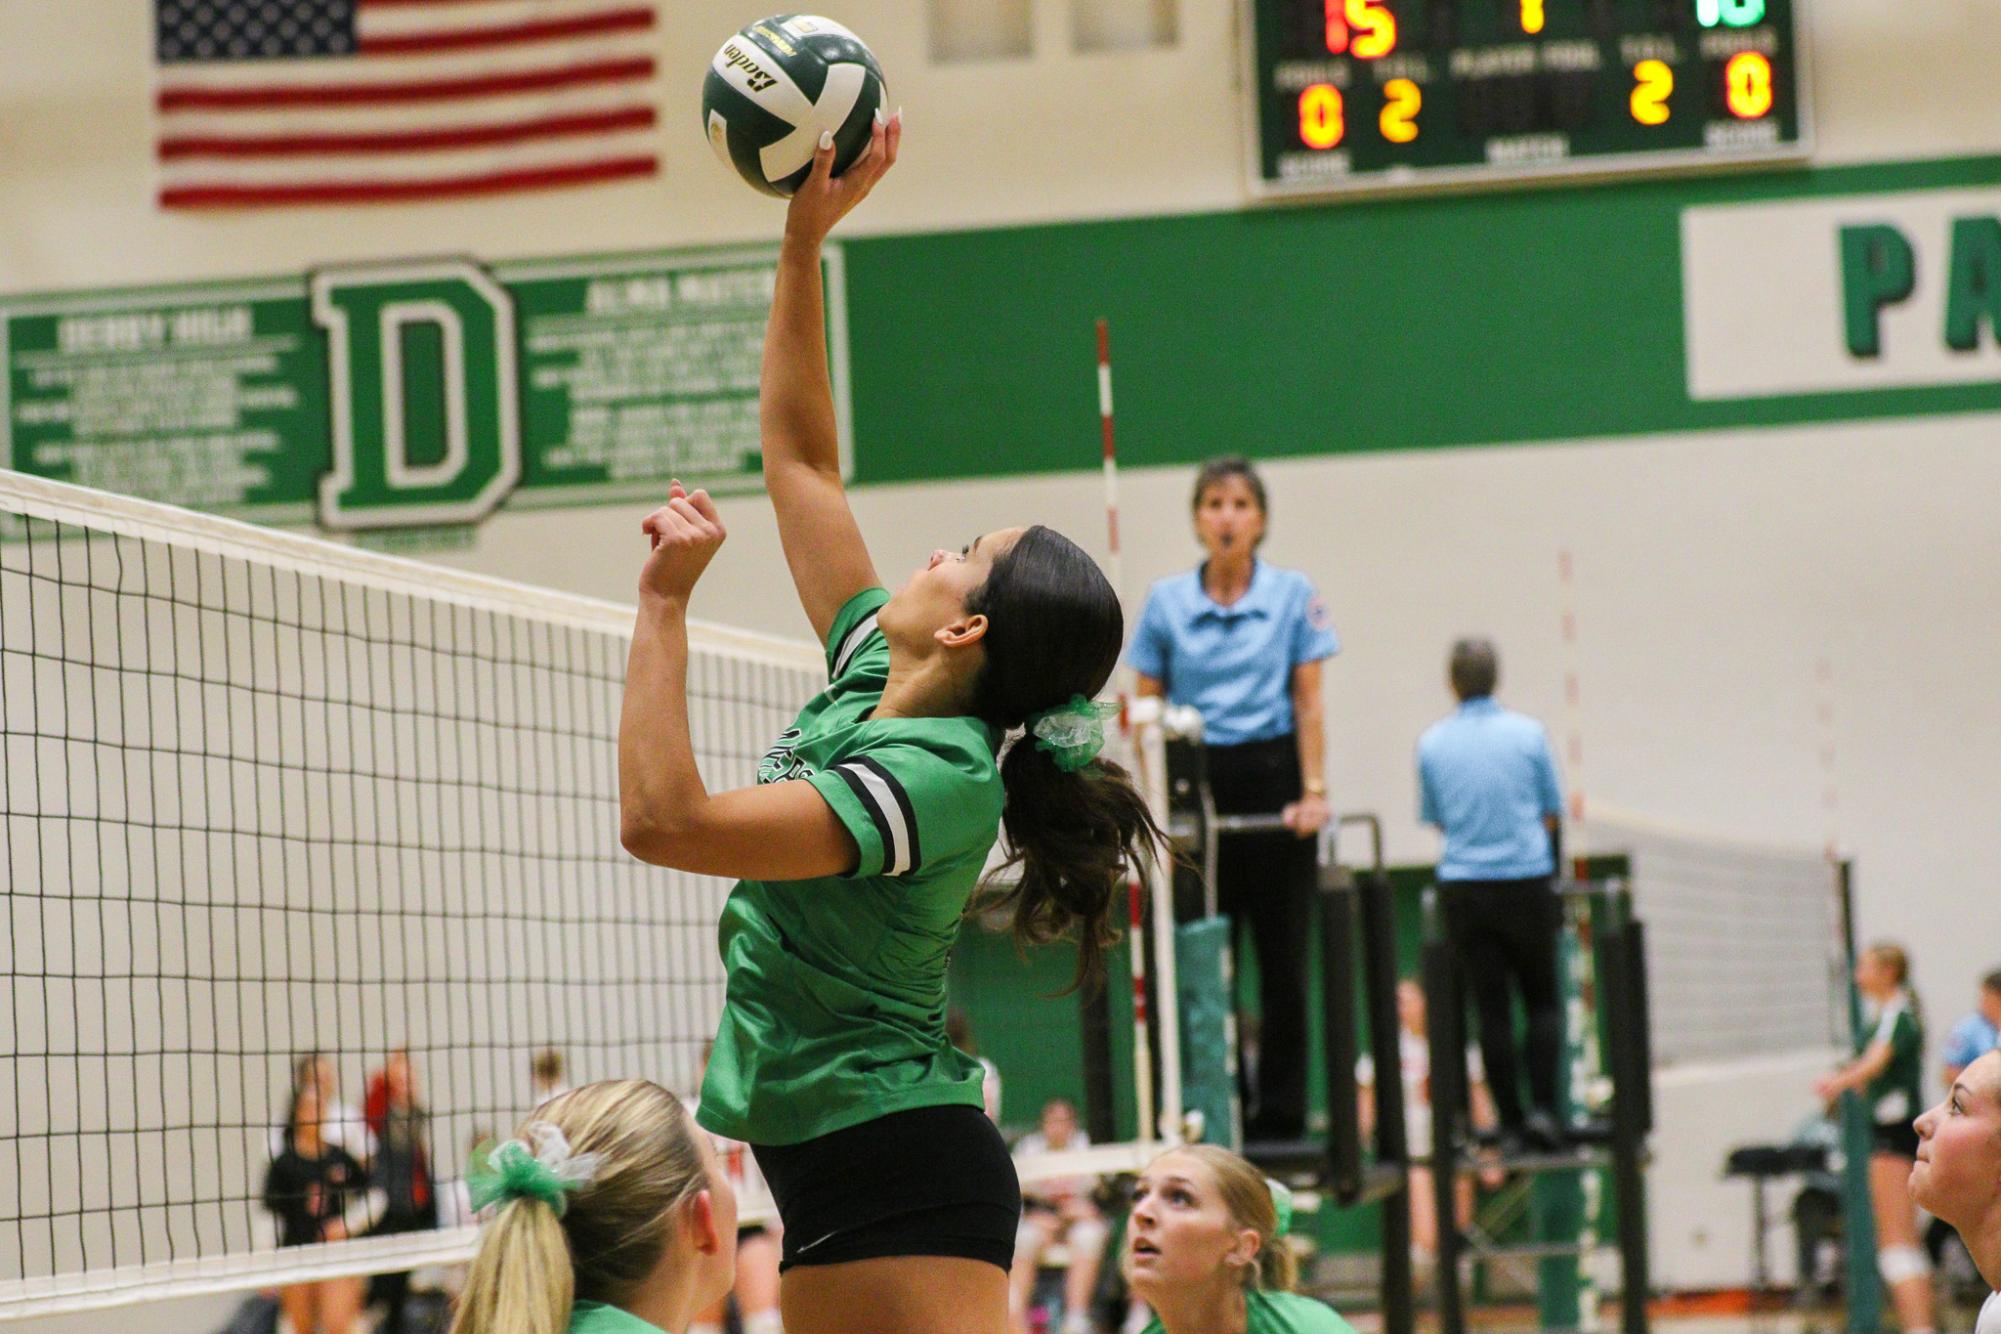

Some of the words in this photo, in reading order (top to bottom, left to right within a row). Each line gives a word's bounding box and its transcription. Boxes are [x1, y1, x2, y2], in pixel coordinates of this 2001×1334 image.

[1325, 0, 1397, 59] 15
[723, 43, 778, 93] Baden
[1630, 58, 1674, 125] 2
[1726, 50, 1773, 120] 0
[1298, 82, 1344, 149] 0
[1379, 78, 1422, 143] 2
[310, 262, 521, 527] D
